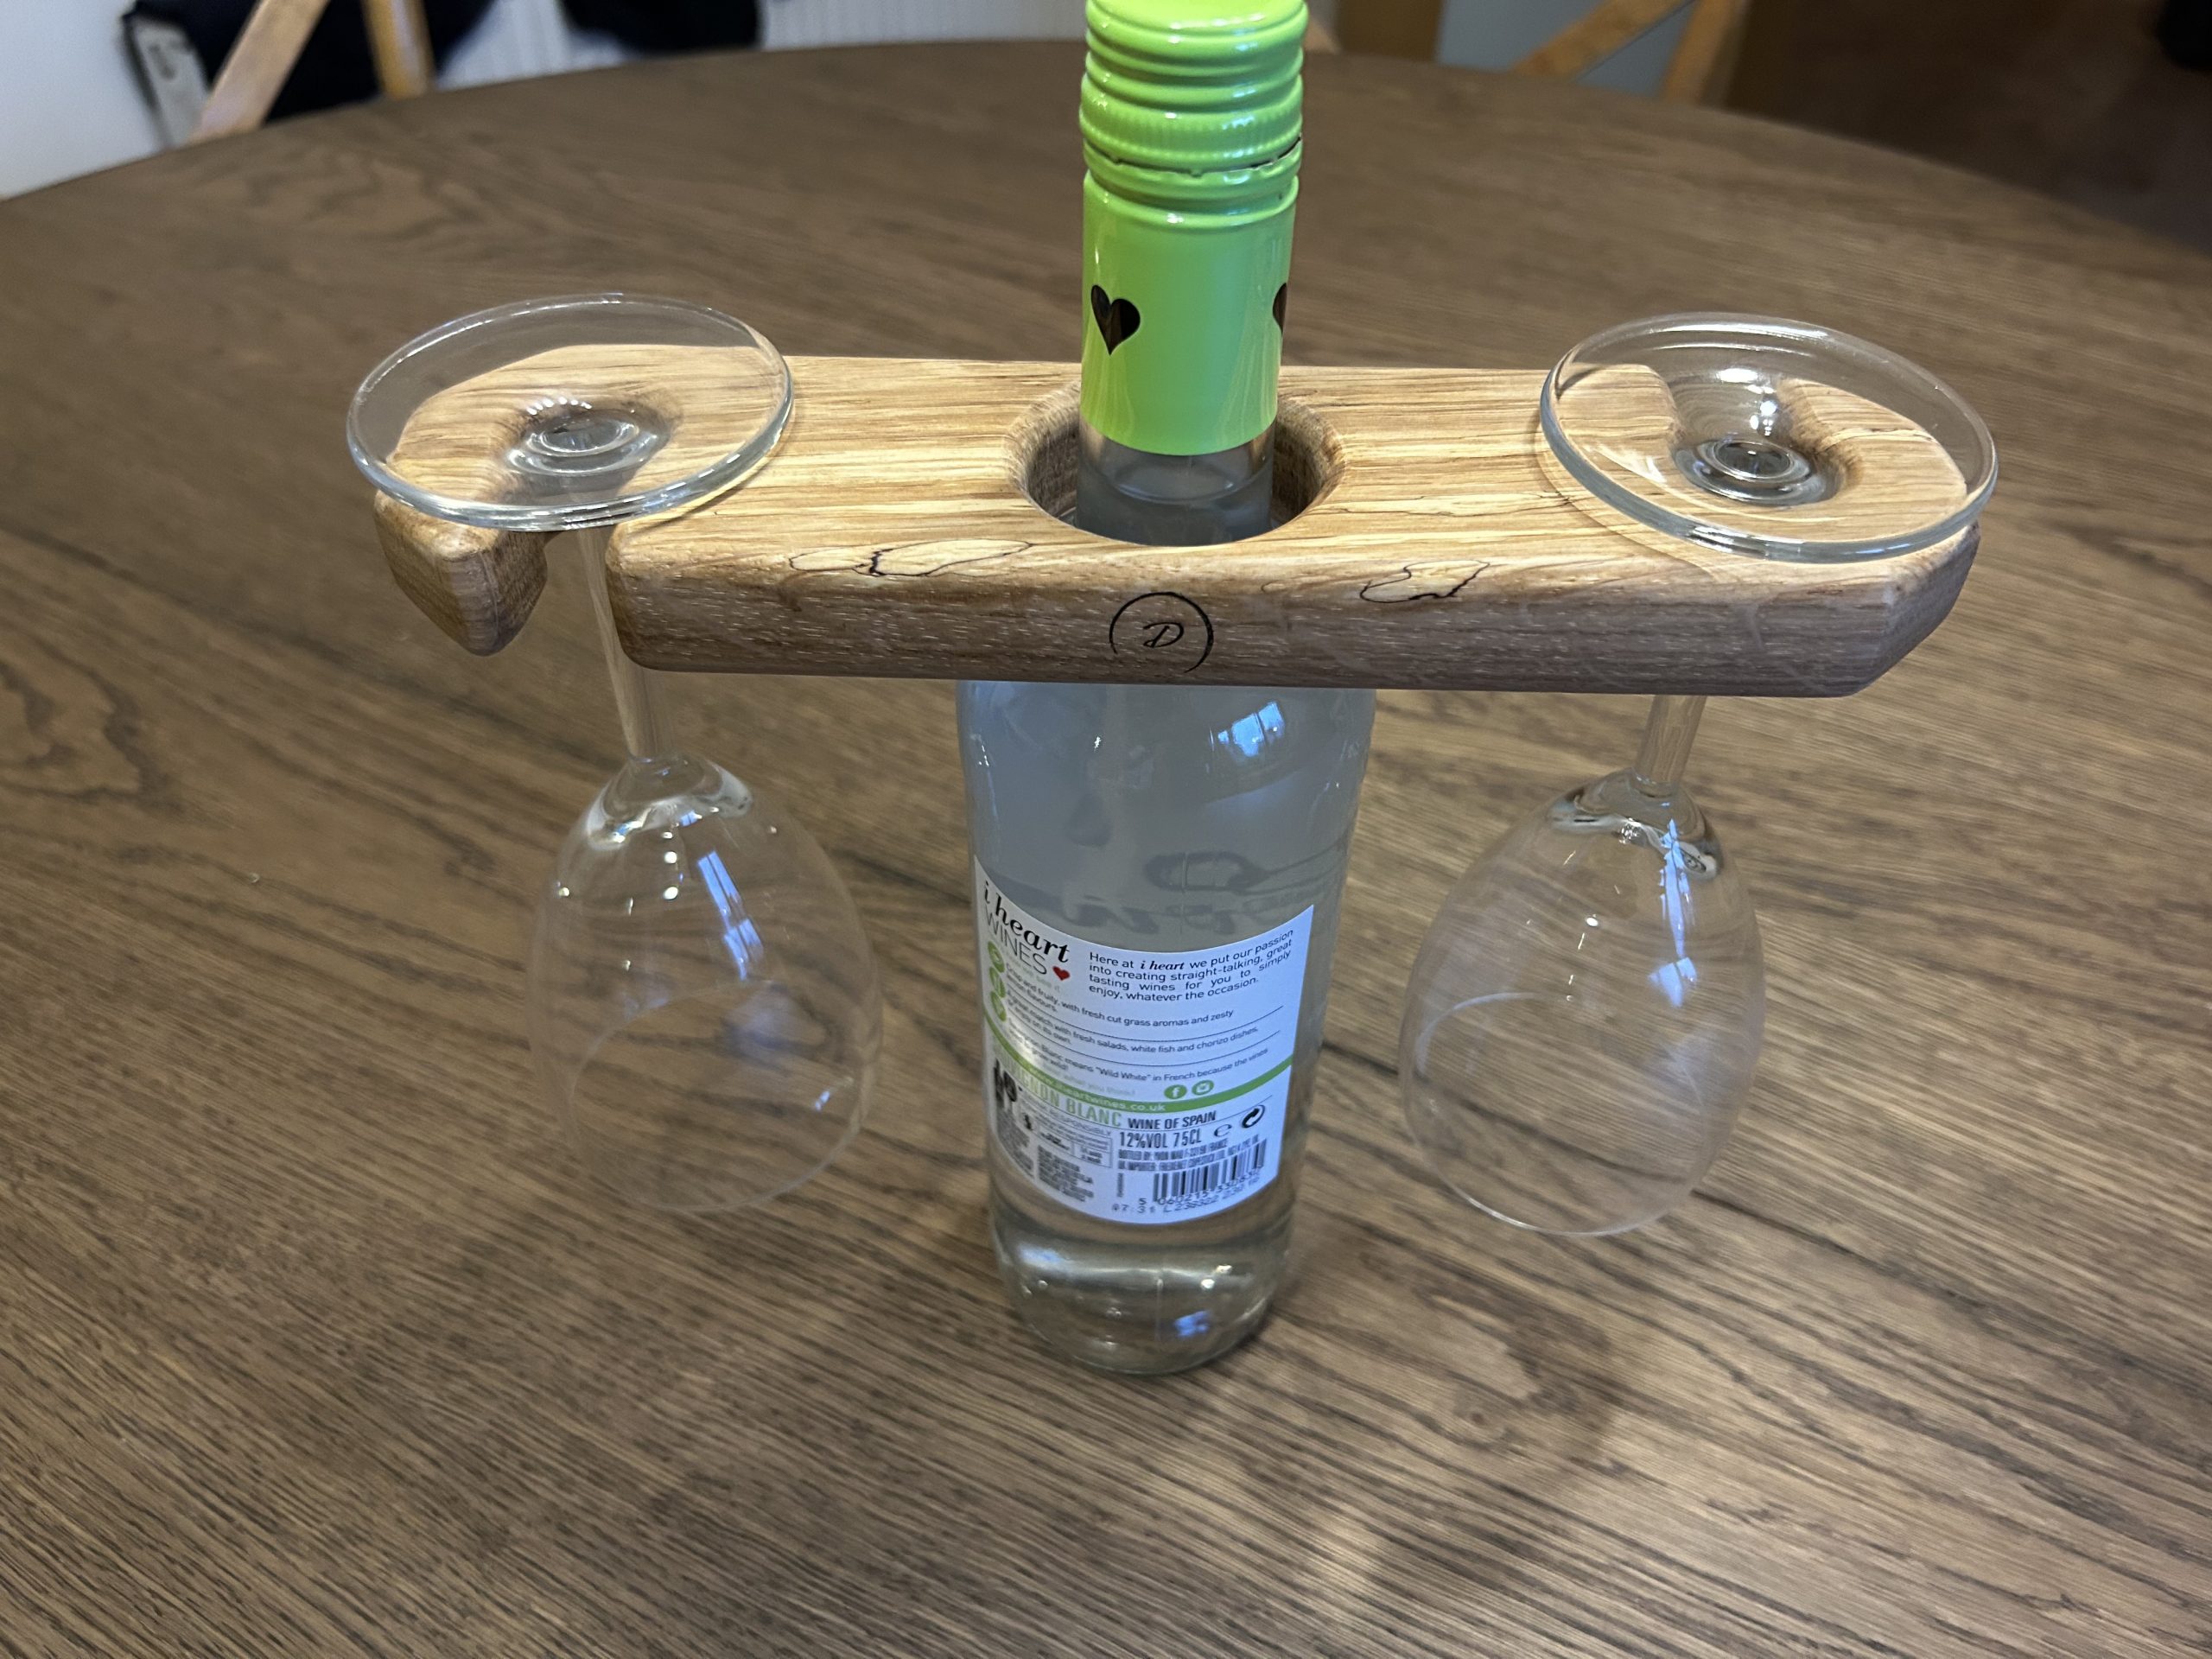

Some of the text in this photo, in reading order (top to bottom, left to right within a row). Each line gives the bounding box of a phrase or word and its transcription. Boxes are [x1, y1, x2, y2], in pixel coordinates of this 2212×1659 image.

[984, 880, 1071, 963] i heart
[985, 904, 1047, 975] WINES
[1090, 951, 1119, 966] Here
[1122, 960, 1134, 969] at
[1149, 960, 1185, 970] heart
[1189, 960, 1207, 969] we
[1211, 954, 1230, 967] put
[1232, 948, 1253, 960] our
[1255, 930, 1294, 955] passion
[1090, 938, 1292, 983] into creating straight-talking, great
[1090, 974, 1129, 991] tasting
[1185, 981, 1202, 990] for
[1211, 976, 1231, 988] you
[1240, 969, 1251, 978] to
[1258, 950, 1291, 971] simply
[1089, 976, 1259, 1001] enjoy, whatever the occasion.
[1061, 1001, 1080, 1013] with
[1082, 1007, 1105, 1020] fresh
[1123, 1018, 1151, 1027] grass
[1191, 1015, 1209, 1024] and
[1211, 1009, 1234, 1020] zesty
[1073, 1032, 1095, 1044] fresh
[1158, 1045, 1175, 1053] fish
[1177, 1044, 1194, 1052] and
[1196, 1037, 1228, 1050] chorizo
[1163, 1072, 1195, 1081] French
[1197, 1063, 1233, 1077] because
[1234, 1057, 1248, 1067] the
[1066, 1097, 1122, 1127] BLANC
[1128, 1110, 1217, 1129] WINE OF SPAIN
[1173, 1128, 1202, 1147] 75CL
